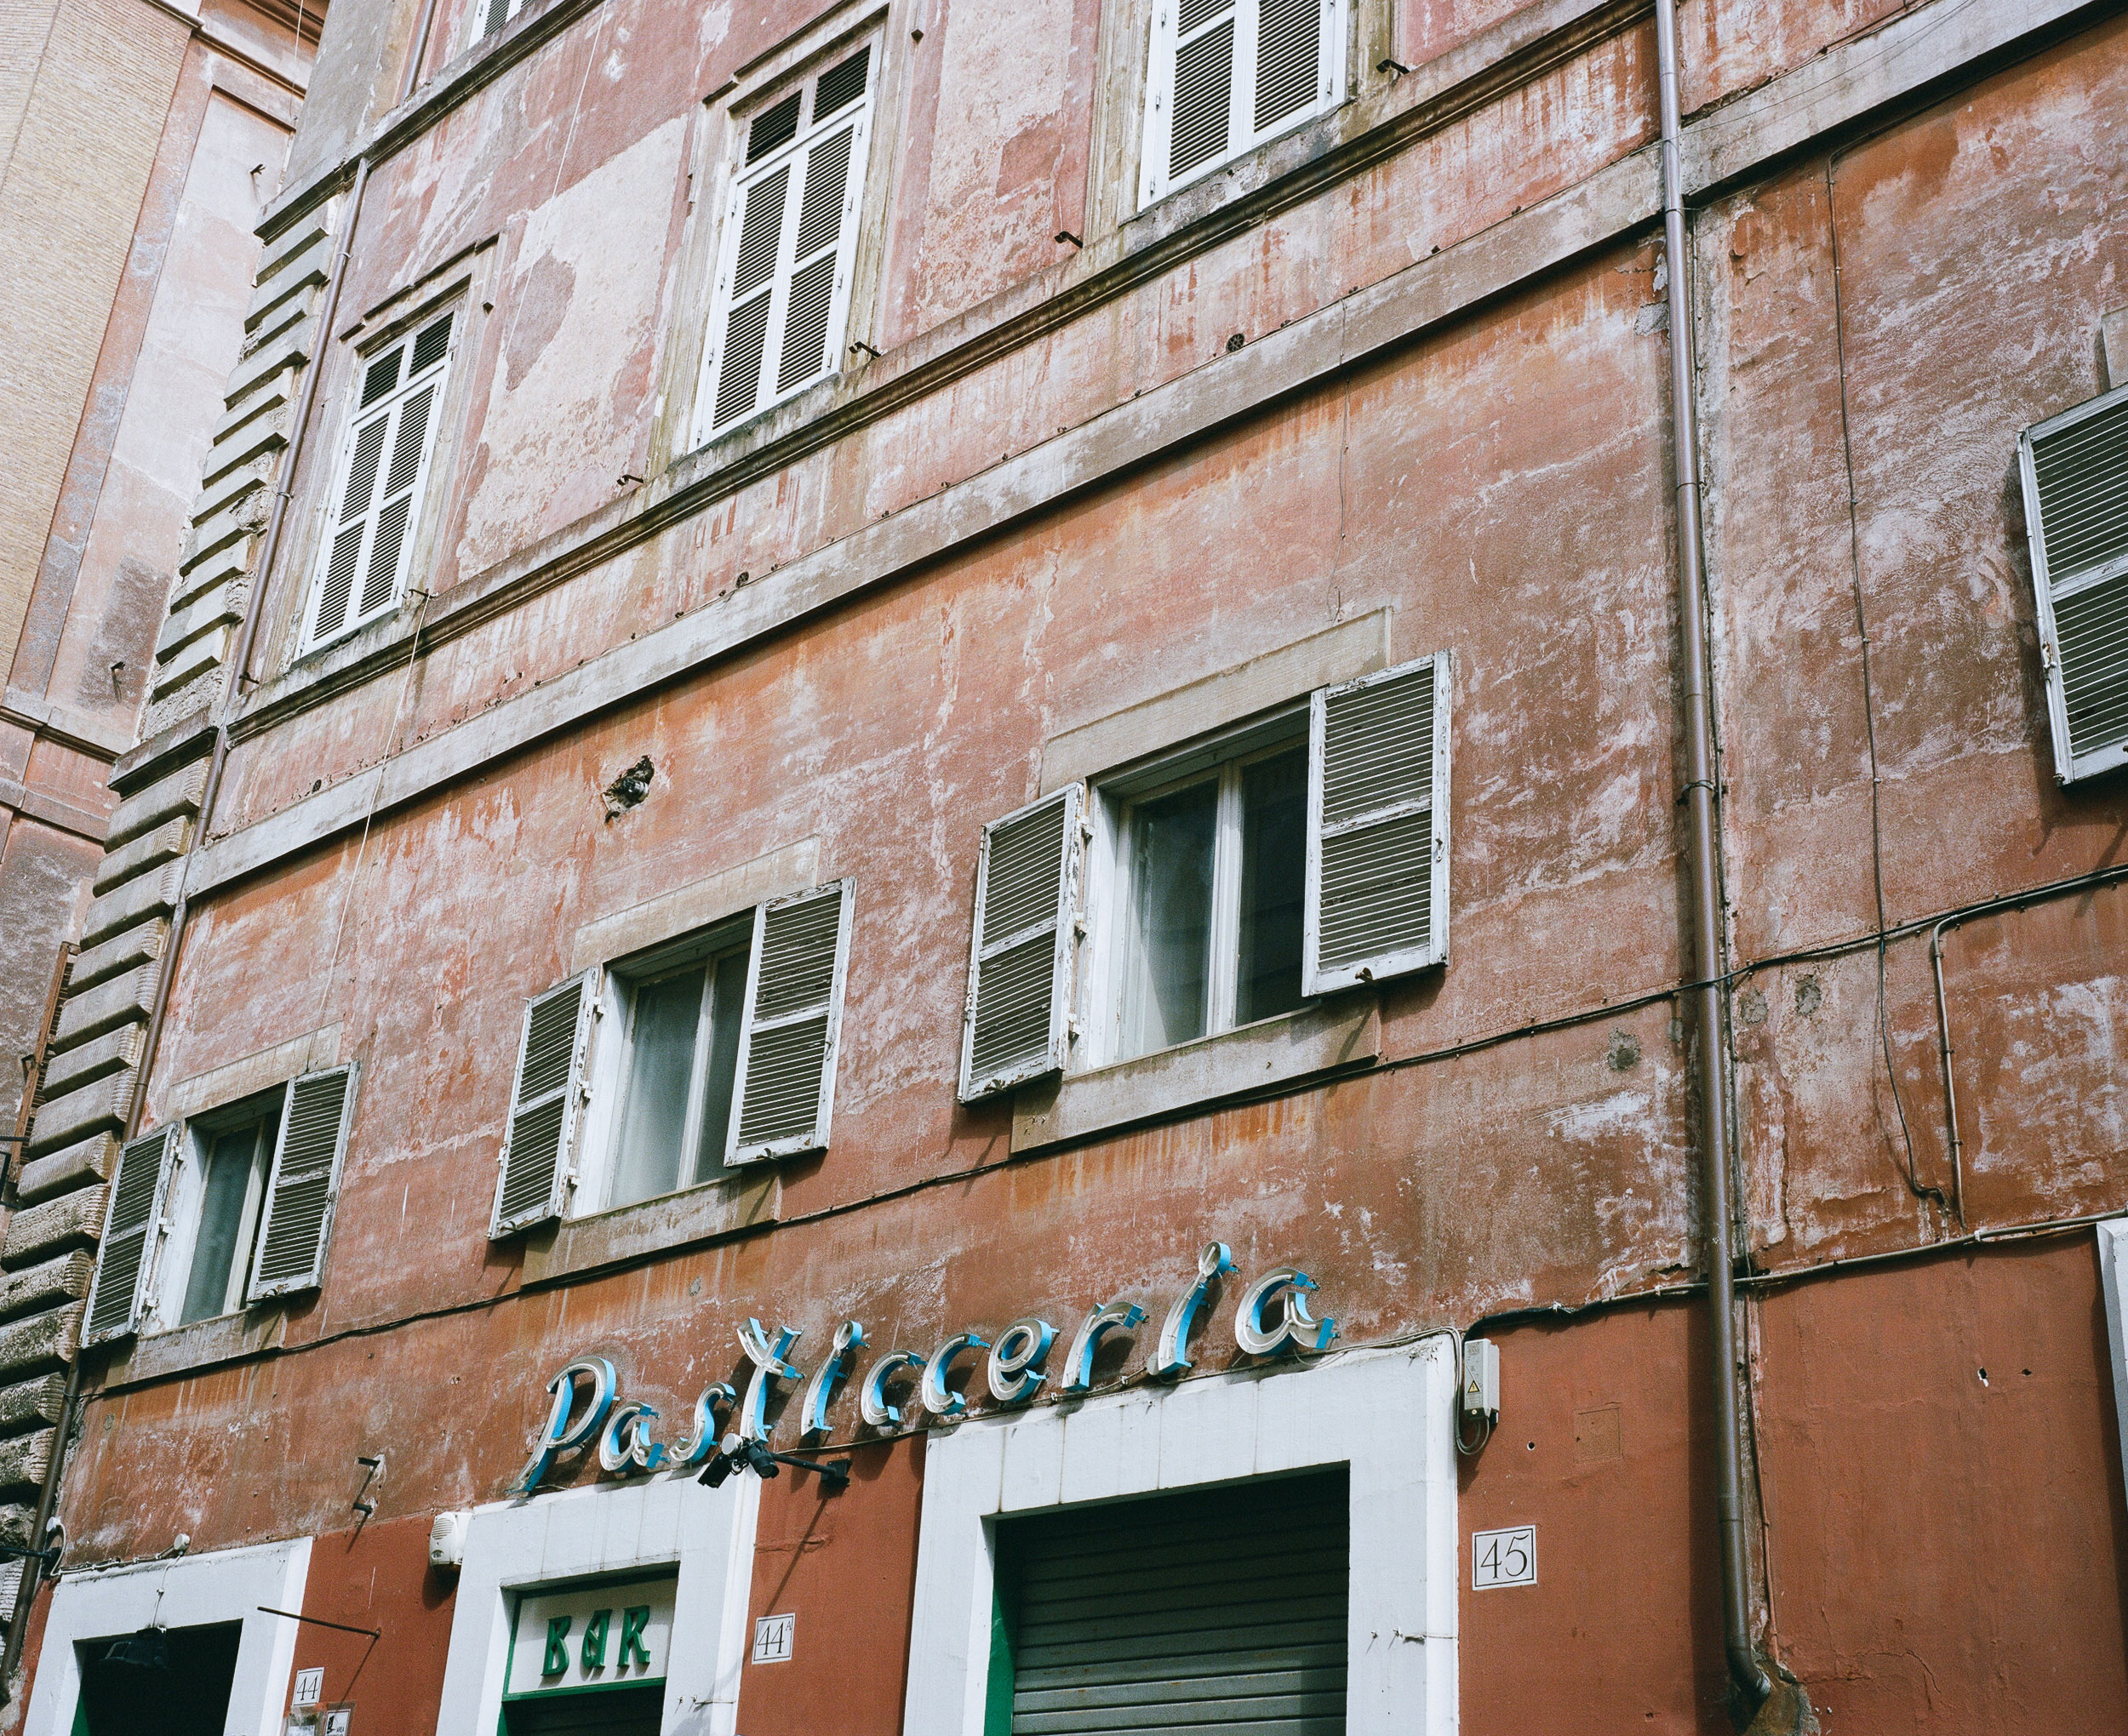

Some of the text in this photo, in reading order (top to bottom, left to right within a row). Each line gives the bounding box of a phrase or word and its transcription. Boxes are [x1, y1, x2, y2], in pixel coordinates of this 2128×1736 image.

[506, 1241, 1338, 1493] Pasticceria
[1480, 1533, 1529, 1579] 45
[541, 1605, 651, 1676] BAR
[296, 1675, 318, 1701] 44
